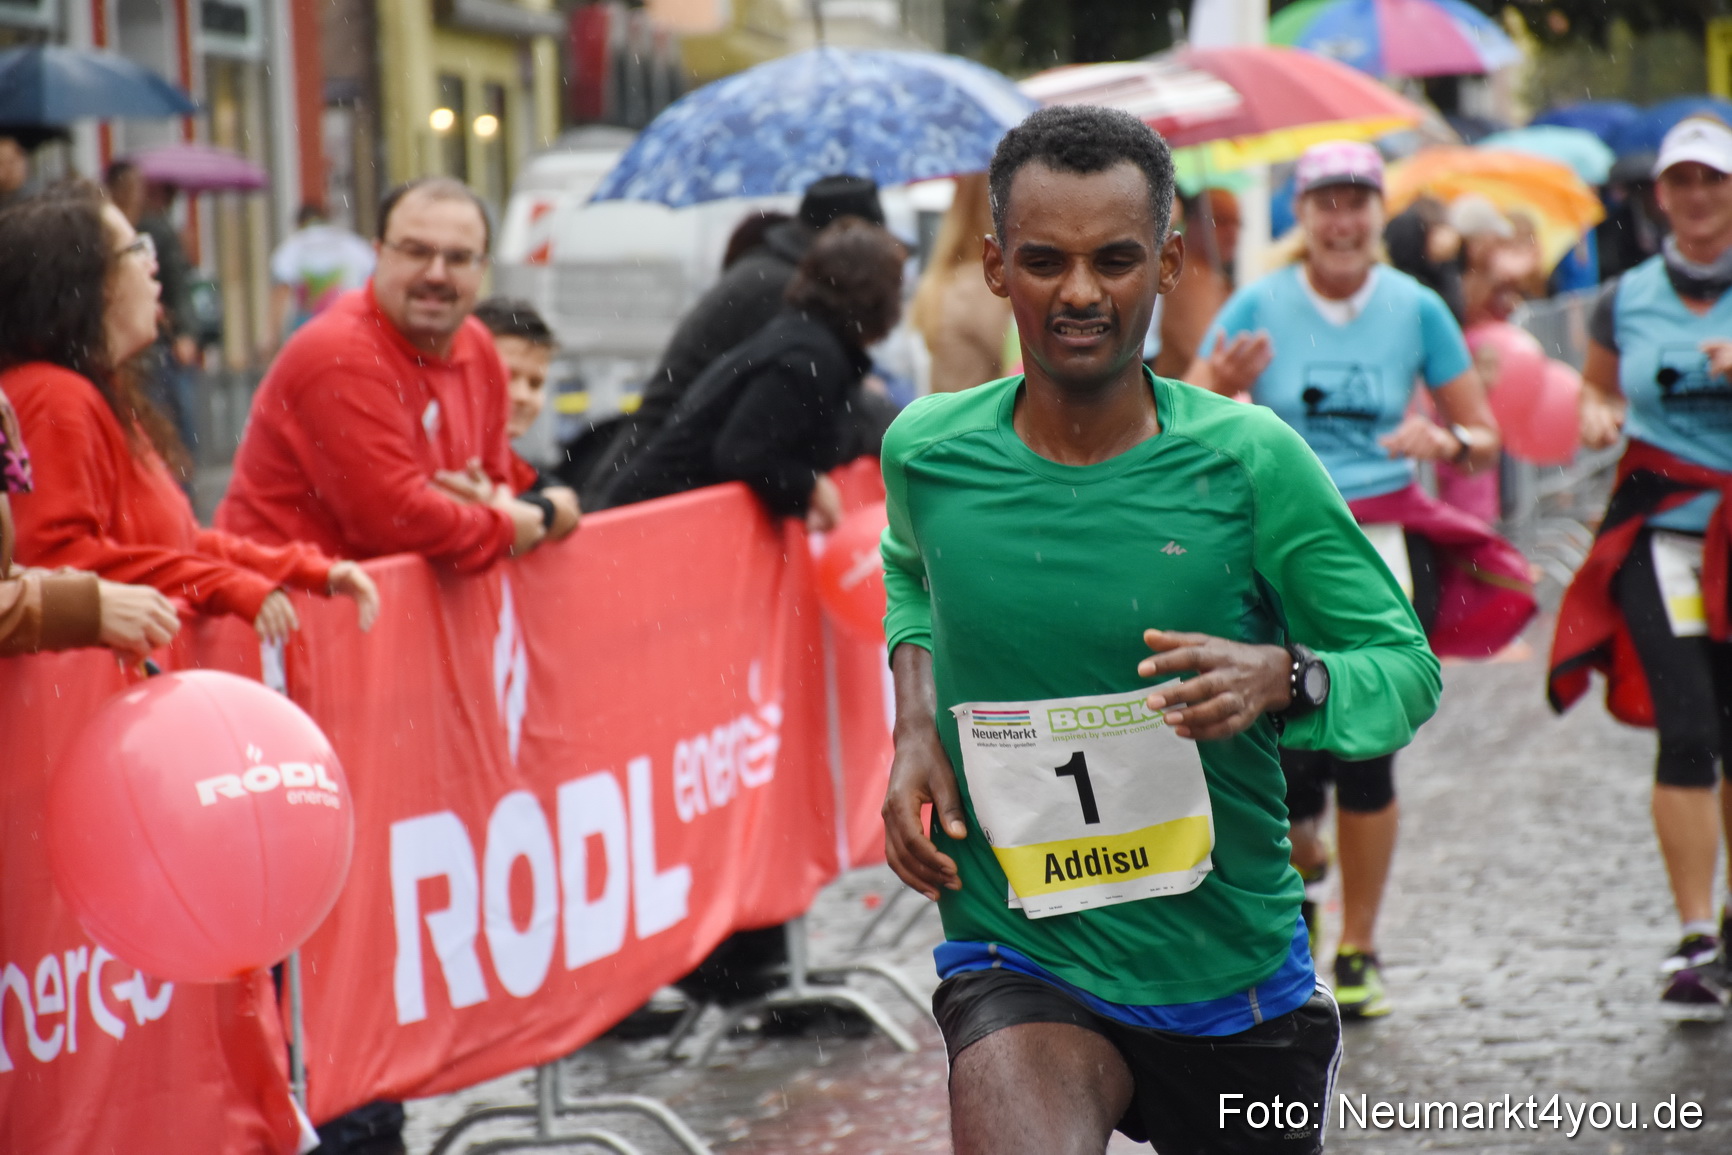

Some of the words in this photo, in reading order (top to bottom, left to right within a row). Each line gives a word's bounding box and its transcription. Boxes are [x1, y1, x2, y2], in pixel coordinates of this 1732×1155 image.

[972, 728, 1037, 739] NeuerMarkt
[1052, 731, 1087, 742] inspired
[1089, 731, 1099, 740] by
[1102, 729, 1127, 737] smart
[1054, 751, 1100, 825] 1
[1044, 846, 1149, 885] Addisu
